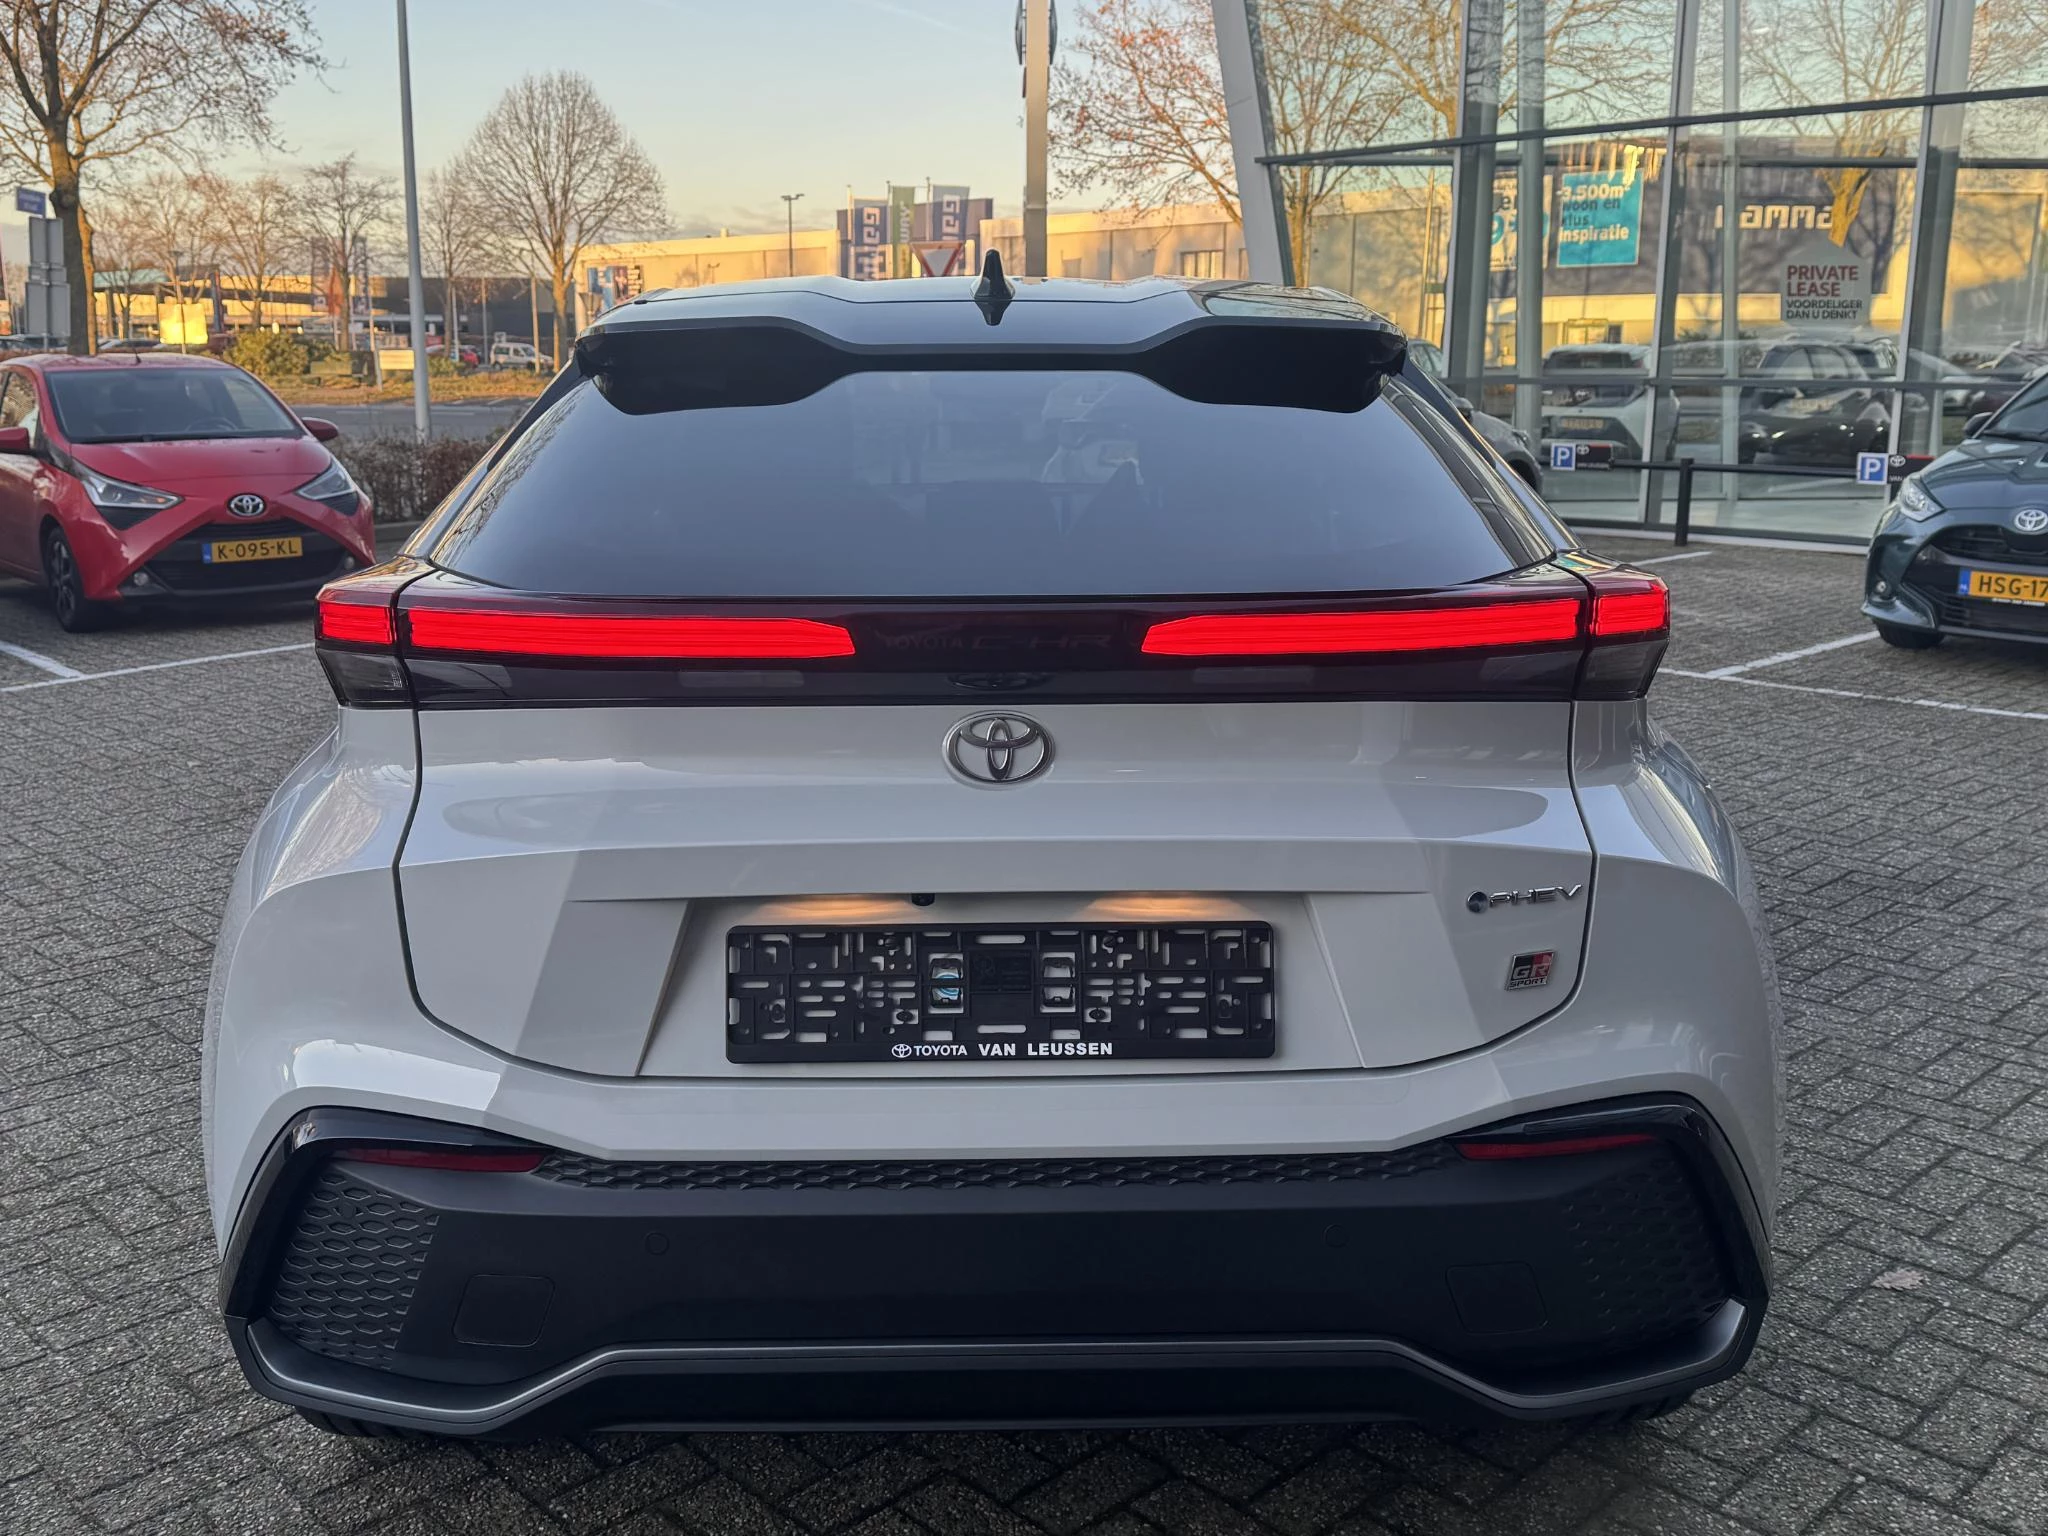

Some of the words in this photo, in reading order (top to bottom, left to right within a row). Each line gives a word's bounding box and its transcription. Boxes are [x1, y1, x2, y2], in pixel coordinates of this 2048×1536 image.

[1787, 265, 1859, 281] PRIVATE
[1787, 282, 1841, 297] LEASE
[1787, 300, 1863, 309] VOORDELIGER
[1786, 310, 1808, 319] DAN
[1811, 310, 1820, 319] U
[1822, 310, 1857, 319] DENKT
[1557, 447, 1570, 466] P
[1864, 458, 1881, 480] P
[217, 540, 298, 560] K-095-KL
[884, 635, 964, 649] TOYOTA
[972, 634, 1112, 649] C-HR
[1489, 884, 1582, 907] PHEV
[1511, 963, 1550, 980] GR
[1509, 977, 1546, 988] SPORT
[913, 1045, 968, 1056] TOYOTA
[978, 1043, 1016, 1056] VAN
[1027, 1042, 1113, 1056] LEUSSEN
